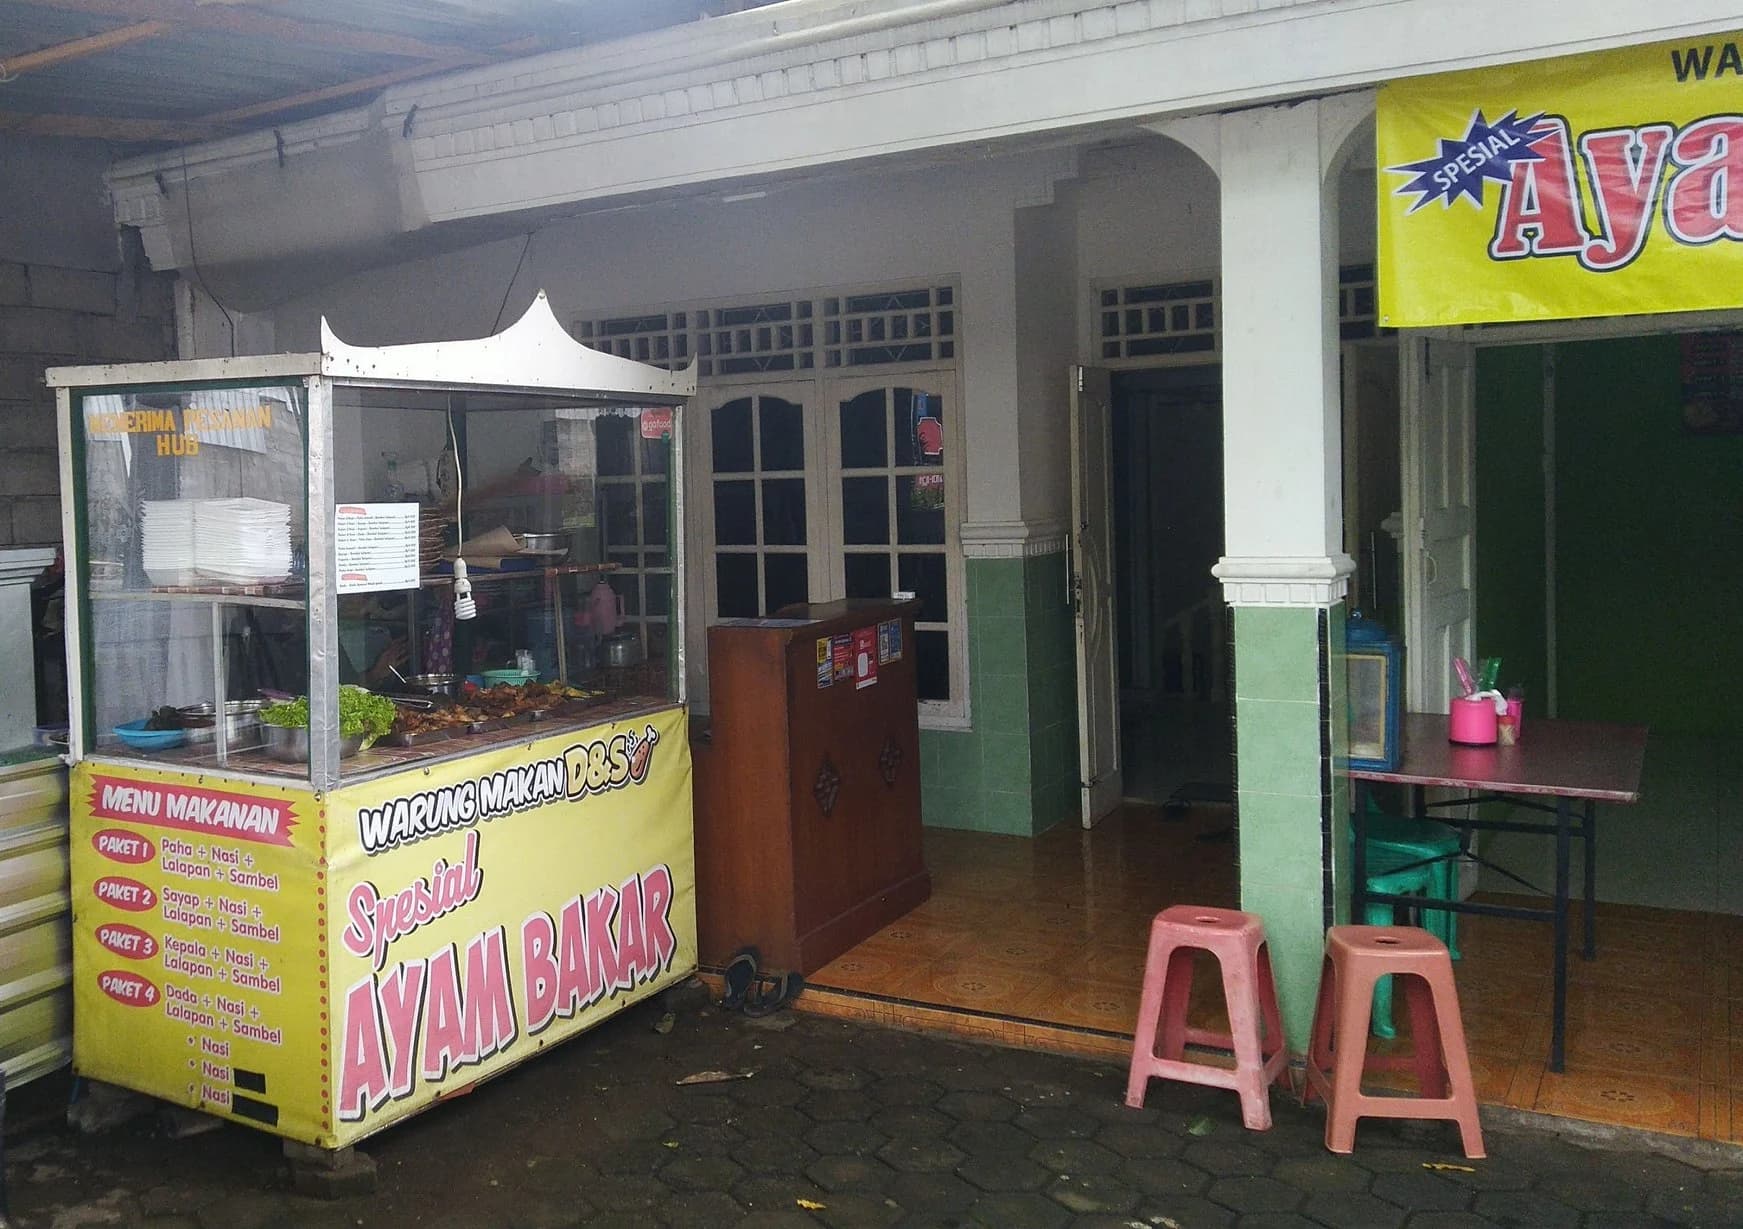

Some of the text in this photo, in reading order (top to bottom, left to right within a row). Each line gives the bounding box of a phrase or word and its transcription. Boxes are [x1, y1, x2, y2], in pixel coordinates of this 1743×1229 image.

[1432, 127, 1521, 192] SPESIAL
[183, 405, 272, 432] PESANAN
[157, 433, 200, 456] HUB
[359, 734, 630, 854] WARUNG MAKAN D&S
[102, 784, 280, 835] MENU MAKANAN
[99, 835, 148, 858] PAKET 1
[163, 839, 192, 856] Paha
[212, 847, 239, 864] Nasi
[163, 858, 210, 878] Lalapan
[230, 868, 278, 890] Sambel
[99, 882, 151, 905] PAKET 2
[163, 888, 199, 907] Sayap
[219, 898, 247, 916] Nasi
[344, 830, 482, 970] Spesial
[164, 906, 211, 928] Lalapan
[231, 919, 279, 941] Sambel
[100, 929, 152, 955] PAKET 3
[164, 936, 205, 957] Kepala
[226, 949, 253, 968] Nasi
[102, 976, 154, 1002] PAKET 4
[164, 955, 212, 977] Lalapan
[232, 969, 280, 993] Sambel
[166, 984, 197, 1004] Dada
[217, 996, 244, 1017] Nasi
[338, 864, 676, 1121] AYAM BAKAR
[166, 1003, 214, 1025] Lalapan
[234, 1019, 281, 1044] Sambel
[202, 1037, 230, 1057] Nasi
[202, 1061, 230, 1081] Nasi
[202, 1085, 230, 1105] Nasi
